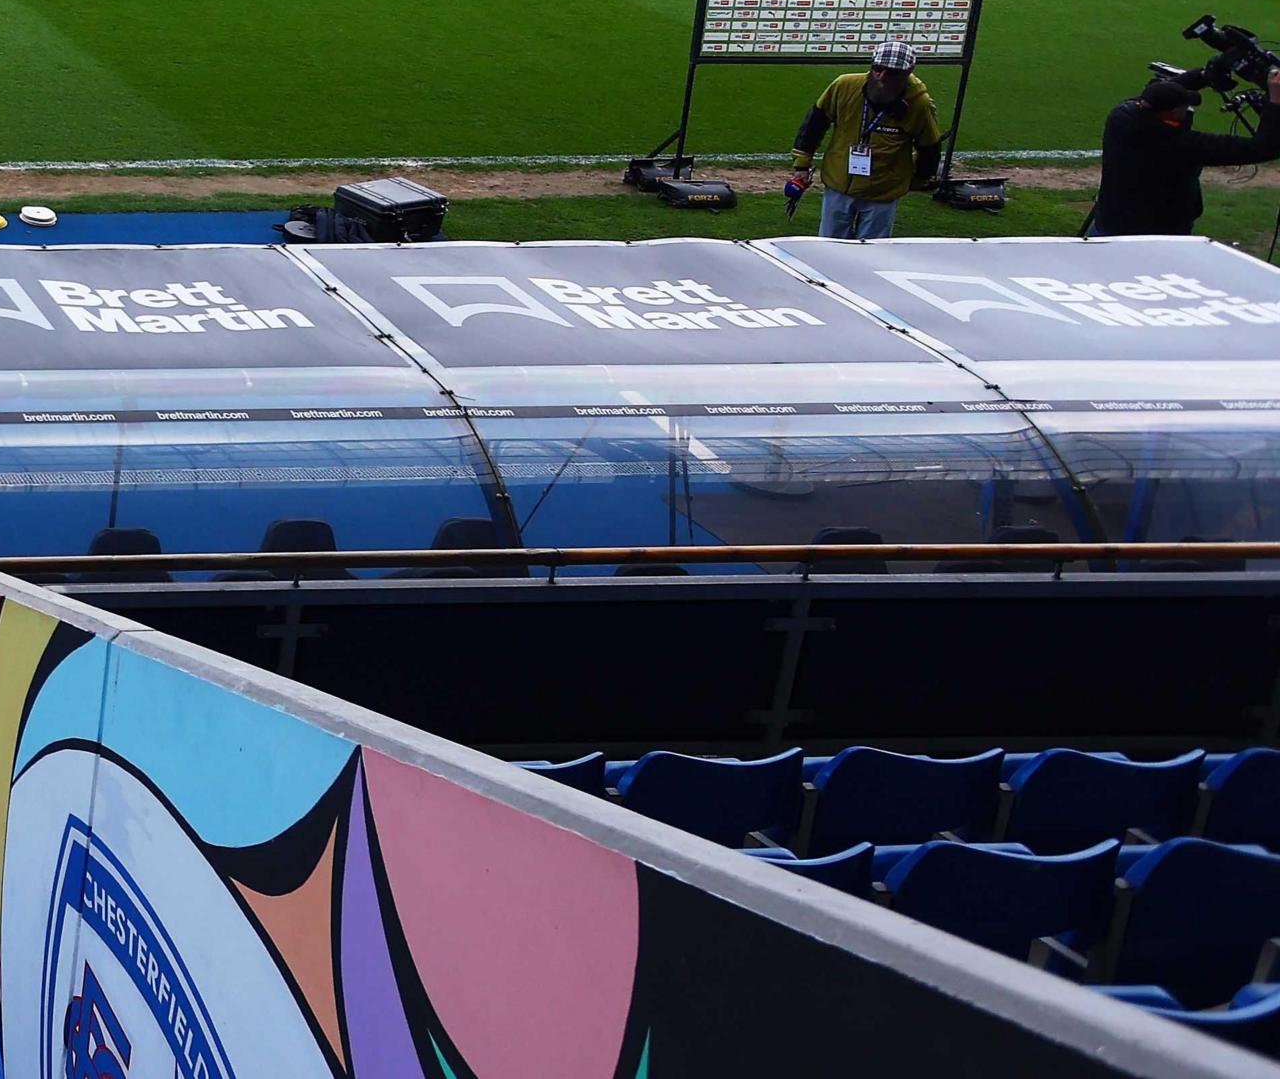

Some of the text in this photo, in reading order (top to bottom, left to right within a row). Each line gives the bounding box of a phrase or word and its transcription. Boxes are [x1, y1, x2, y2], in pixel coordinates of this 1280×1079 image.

[687, 193, 720, 201] FORZA
[529, 276, 734, 305] Brett
[1007, 273, 1229, 302] Brett
[39, 279, 238, 309] Brett
[68, 302, 315, 333] Martin
[574, 299, 826, 331] Martin
[704, 405, 796, 413] brettmartin.com
[834, 404, 926, 412] brettmartin.com
[961, 402, 1053, 410] brettmartin.com
[1090, 401, 1183, 409] brettmartin.com
[290, 410, 383, 418] brettmartin.com
[422, 408, 515, 416] brettmartin.com
[574, 406, 666, 415] brettmartin.com
[23, 413, 116, 421] brettmartin.com
[156, 411, 249, 420] brettmartin.com
[83, 871, 210, 1079] CHESTERFIELD
